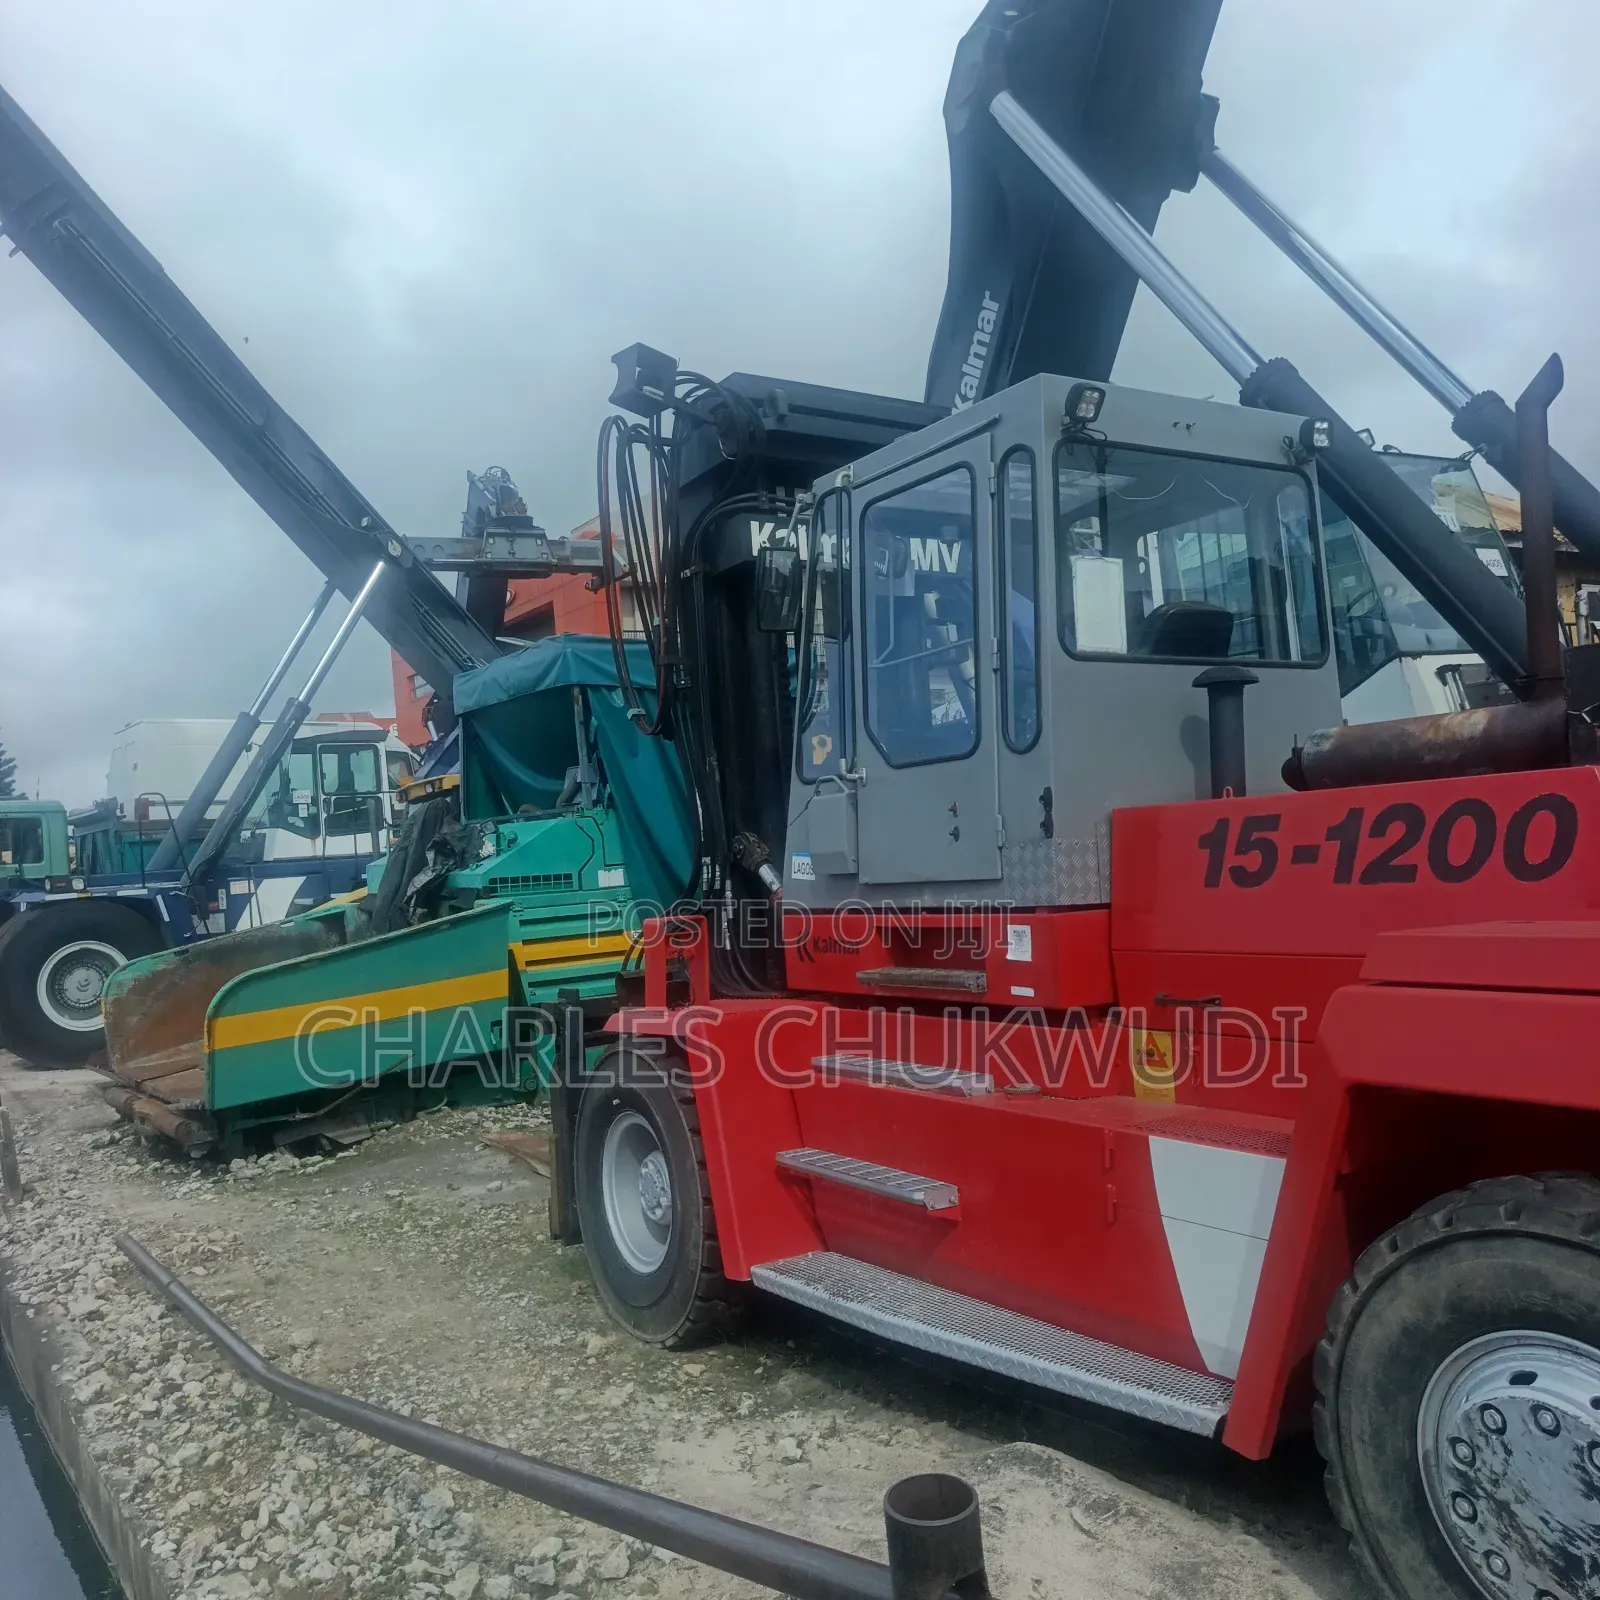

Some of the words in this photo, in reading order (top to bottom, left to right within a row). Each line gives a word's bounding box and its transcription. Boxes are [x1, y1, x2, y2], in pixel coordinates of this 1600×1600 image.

[951, 290, 999, 415] Kalmar
[793, 861, 815, 876] LAGOS
[1197, 793, 1578, 889] 15-1200
[812, 936, 860, 955] Kalmar
